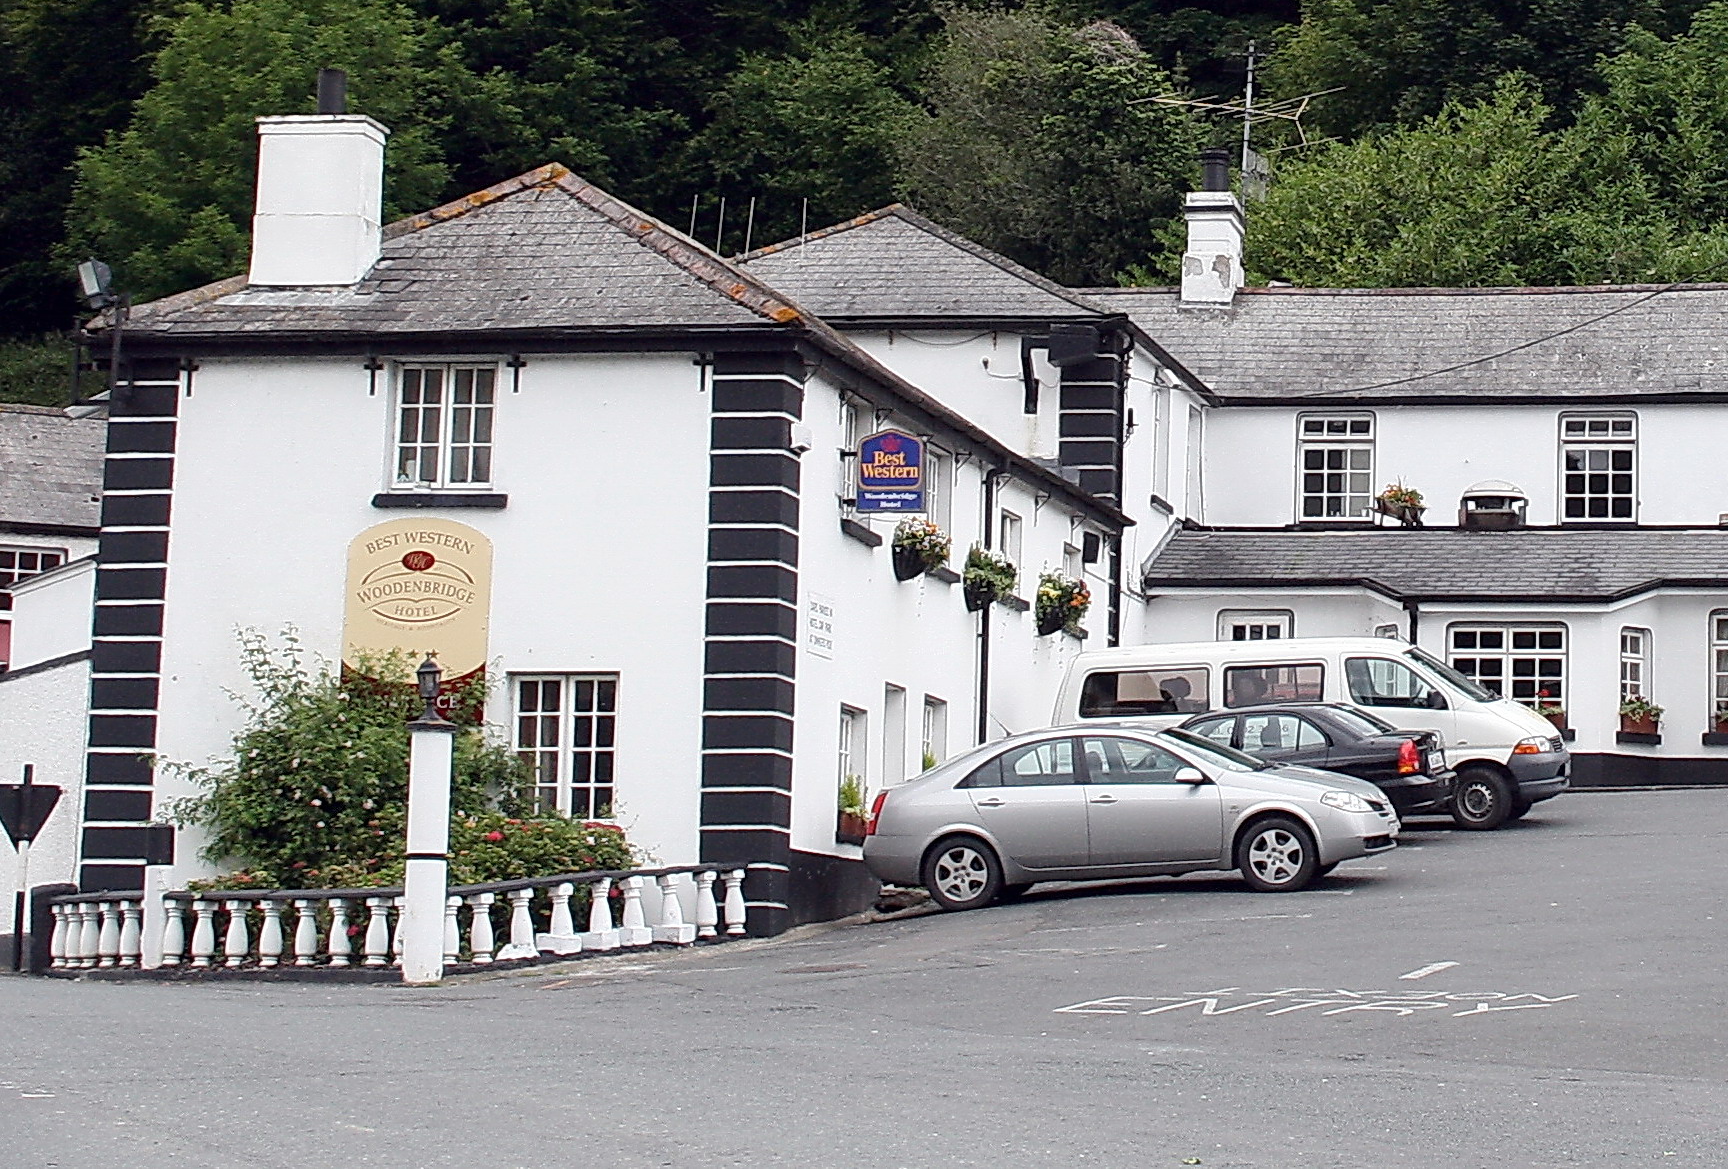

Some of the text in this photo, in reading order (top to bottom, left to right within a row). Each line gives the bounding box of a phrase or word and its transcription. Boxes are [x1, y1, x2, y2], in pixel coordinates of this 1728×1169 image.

[873, 451, 906, 466] Best
[862, 463, 918, 478] Western
[366, 532, 475, 555] BEST WESTERN
[357, 581, 475, 604] WOODENBRIDGE
[394, 605, 437, 617] HOTEL
[1053, 995, 1553, 1017] ENTRY
